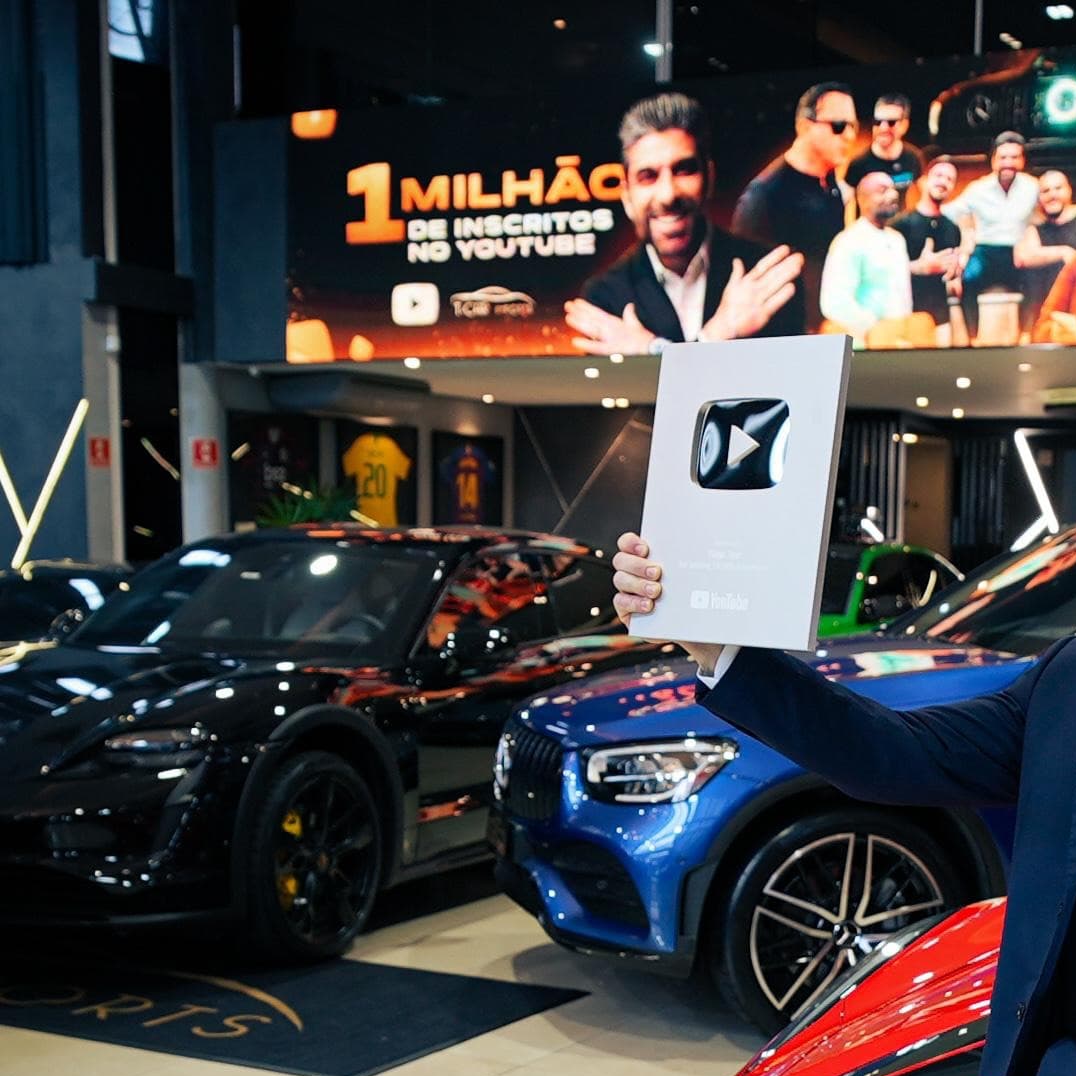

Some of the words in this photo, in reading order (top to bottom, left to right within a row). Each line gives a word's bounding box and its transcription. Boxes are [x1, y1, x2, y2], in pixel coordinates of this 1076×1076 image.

[346, 161, 405, 244] 1
[401, 154, 625, 214] MILHÃO
[407, 218, 448, 241] DE
[453, 208, 614, 238] INSCRITOS
[407, 241, 451, 263] NO
[454, 232, 596, 261] YOUTUBE
[363, 463, 387, 498] 20
